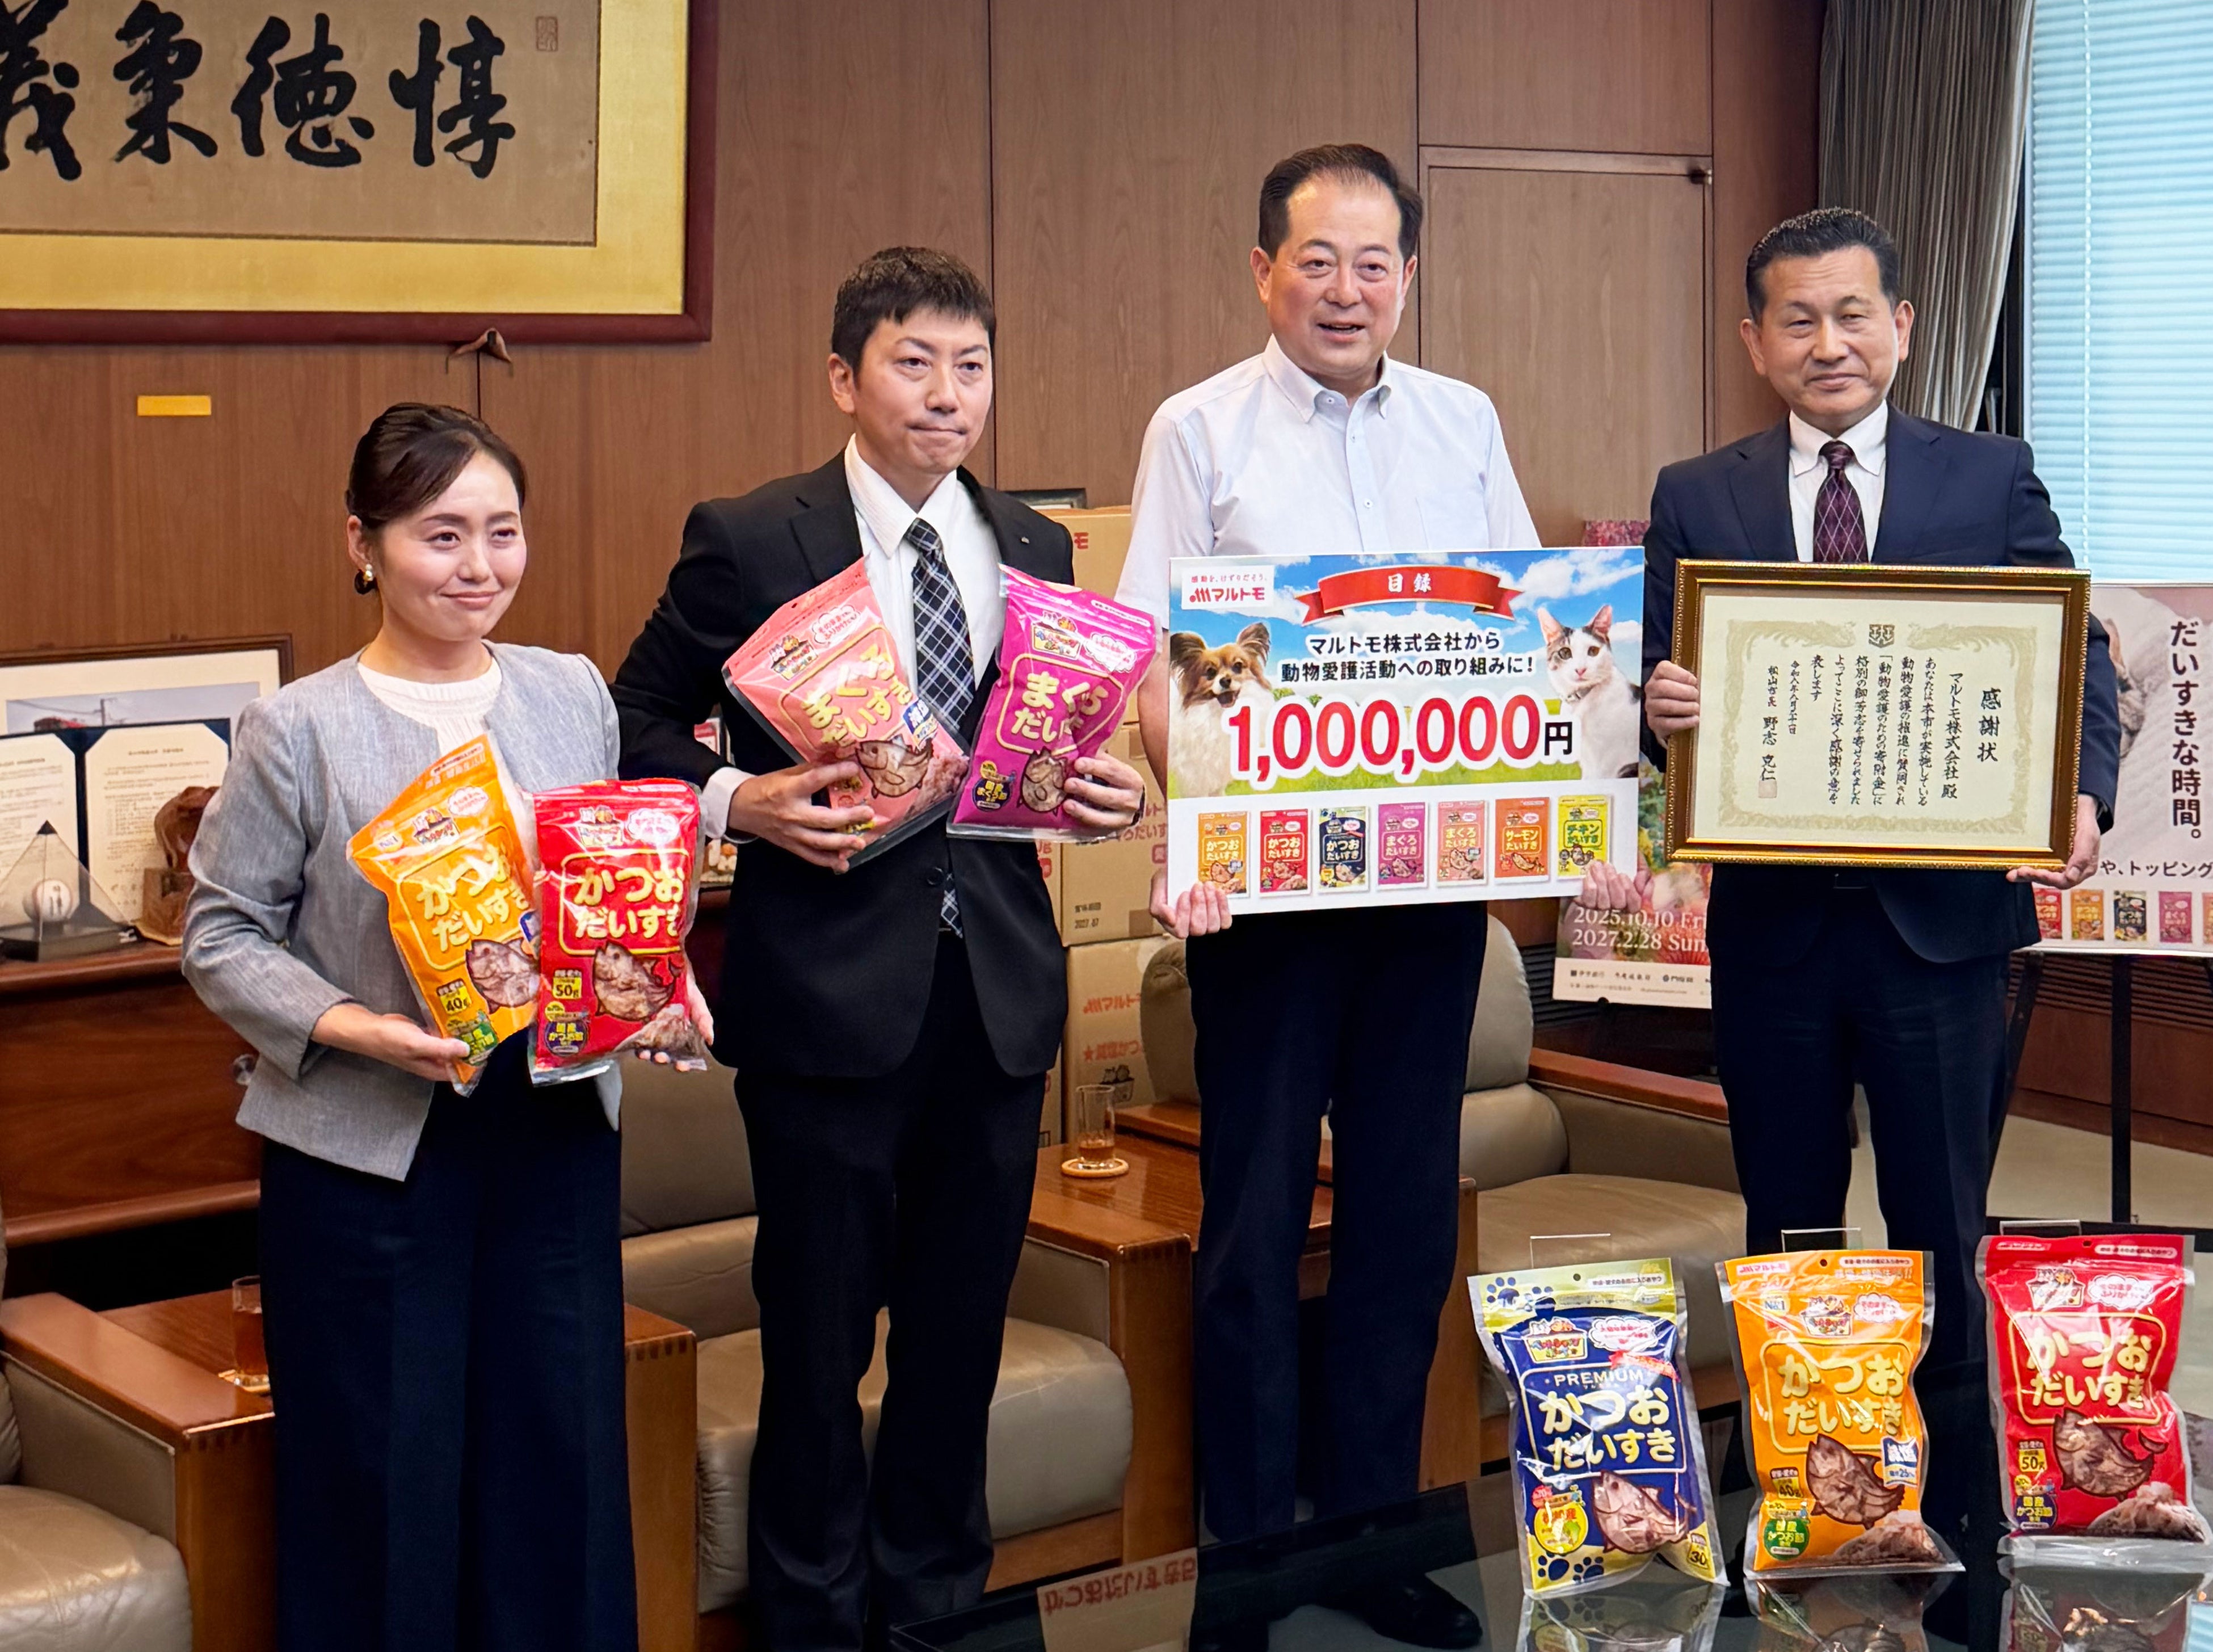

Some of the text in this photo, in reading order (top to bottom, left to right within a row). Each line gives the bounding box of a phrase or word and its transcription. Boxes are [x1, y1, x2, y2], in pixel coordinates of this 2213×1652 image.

[1211, 587, 1265, 602] マルトモ
[1387, 573, 1433, 593] 目録
[1310, 630, 1500, 655] マルトモ株式会社から
[1978, 688, 2001, 762] 感謝状
[2171, 621, 2201, 839] だいすきな時間。
[1268, 837, 1300, 848] かつお
[1326, 839, 1360, 851] かつお
[1506, 830, 1538, 842] サーモン
[574, 865, 683, 906] かつお
[1668, 934, 1706, 952] Sun
[2026, 1327, 2152, 1371] かつお
[1554, 1369, 1643, 1387] PREMIUM
[1777, 1353, 1906, 1398] かつお
[2030, 1370, 2145, 1409] だいすき
[1539, 1384, 1669, 1435] かつお
[1783, 1400, 1904, 1435] だいすき
[1547, 1428, 1676, 1471] だいすき
